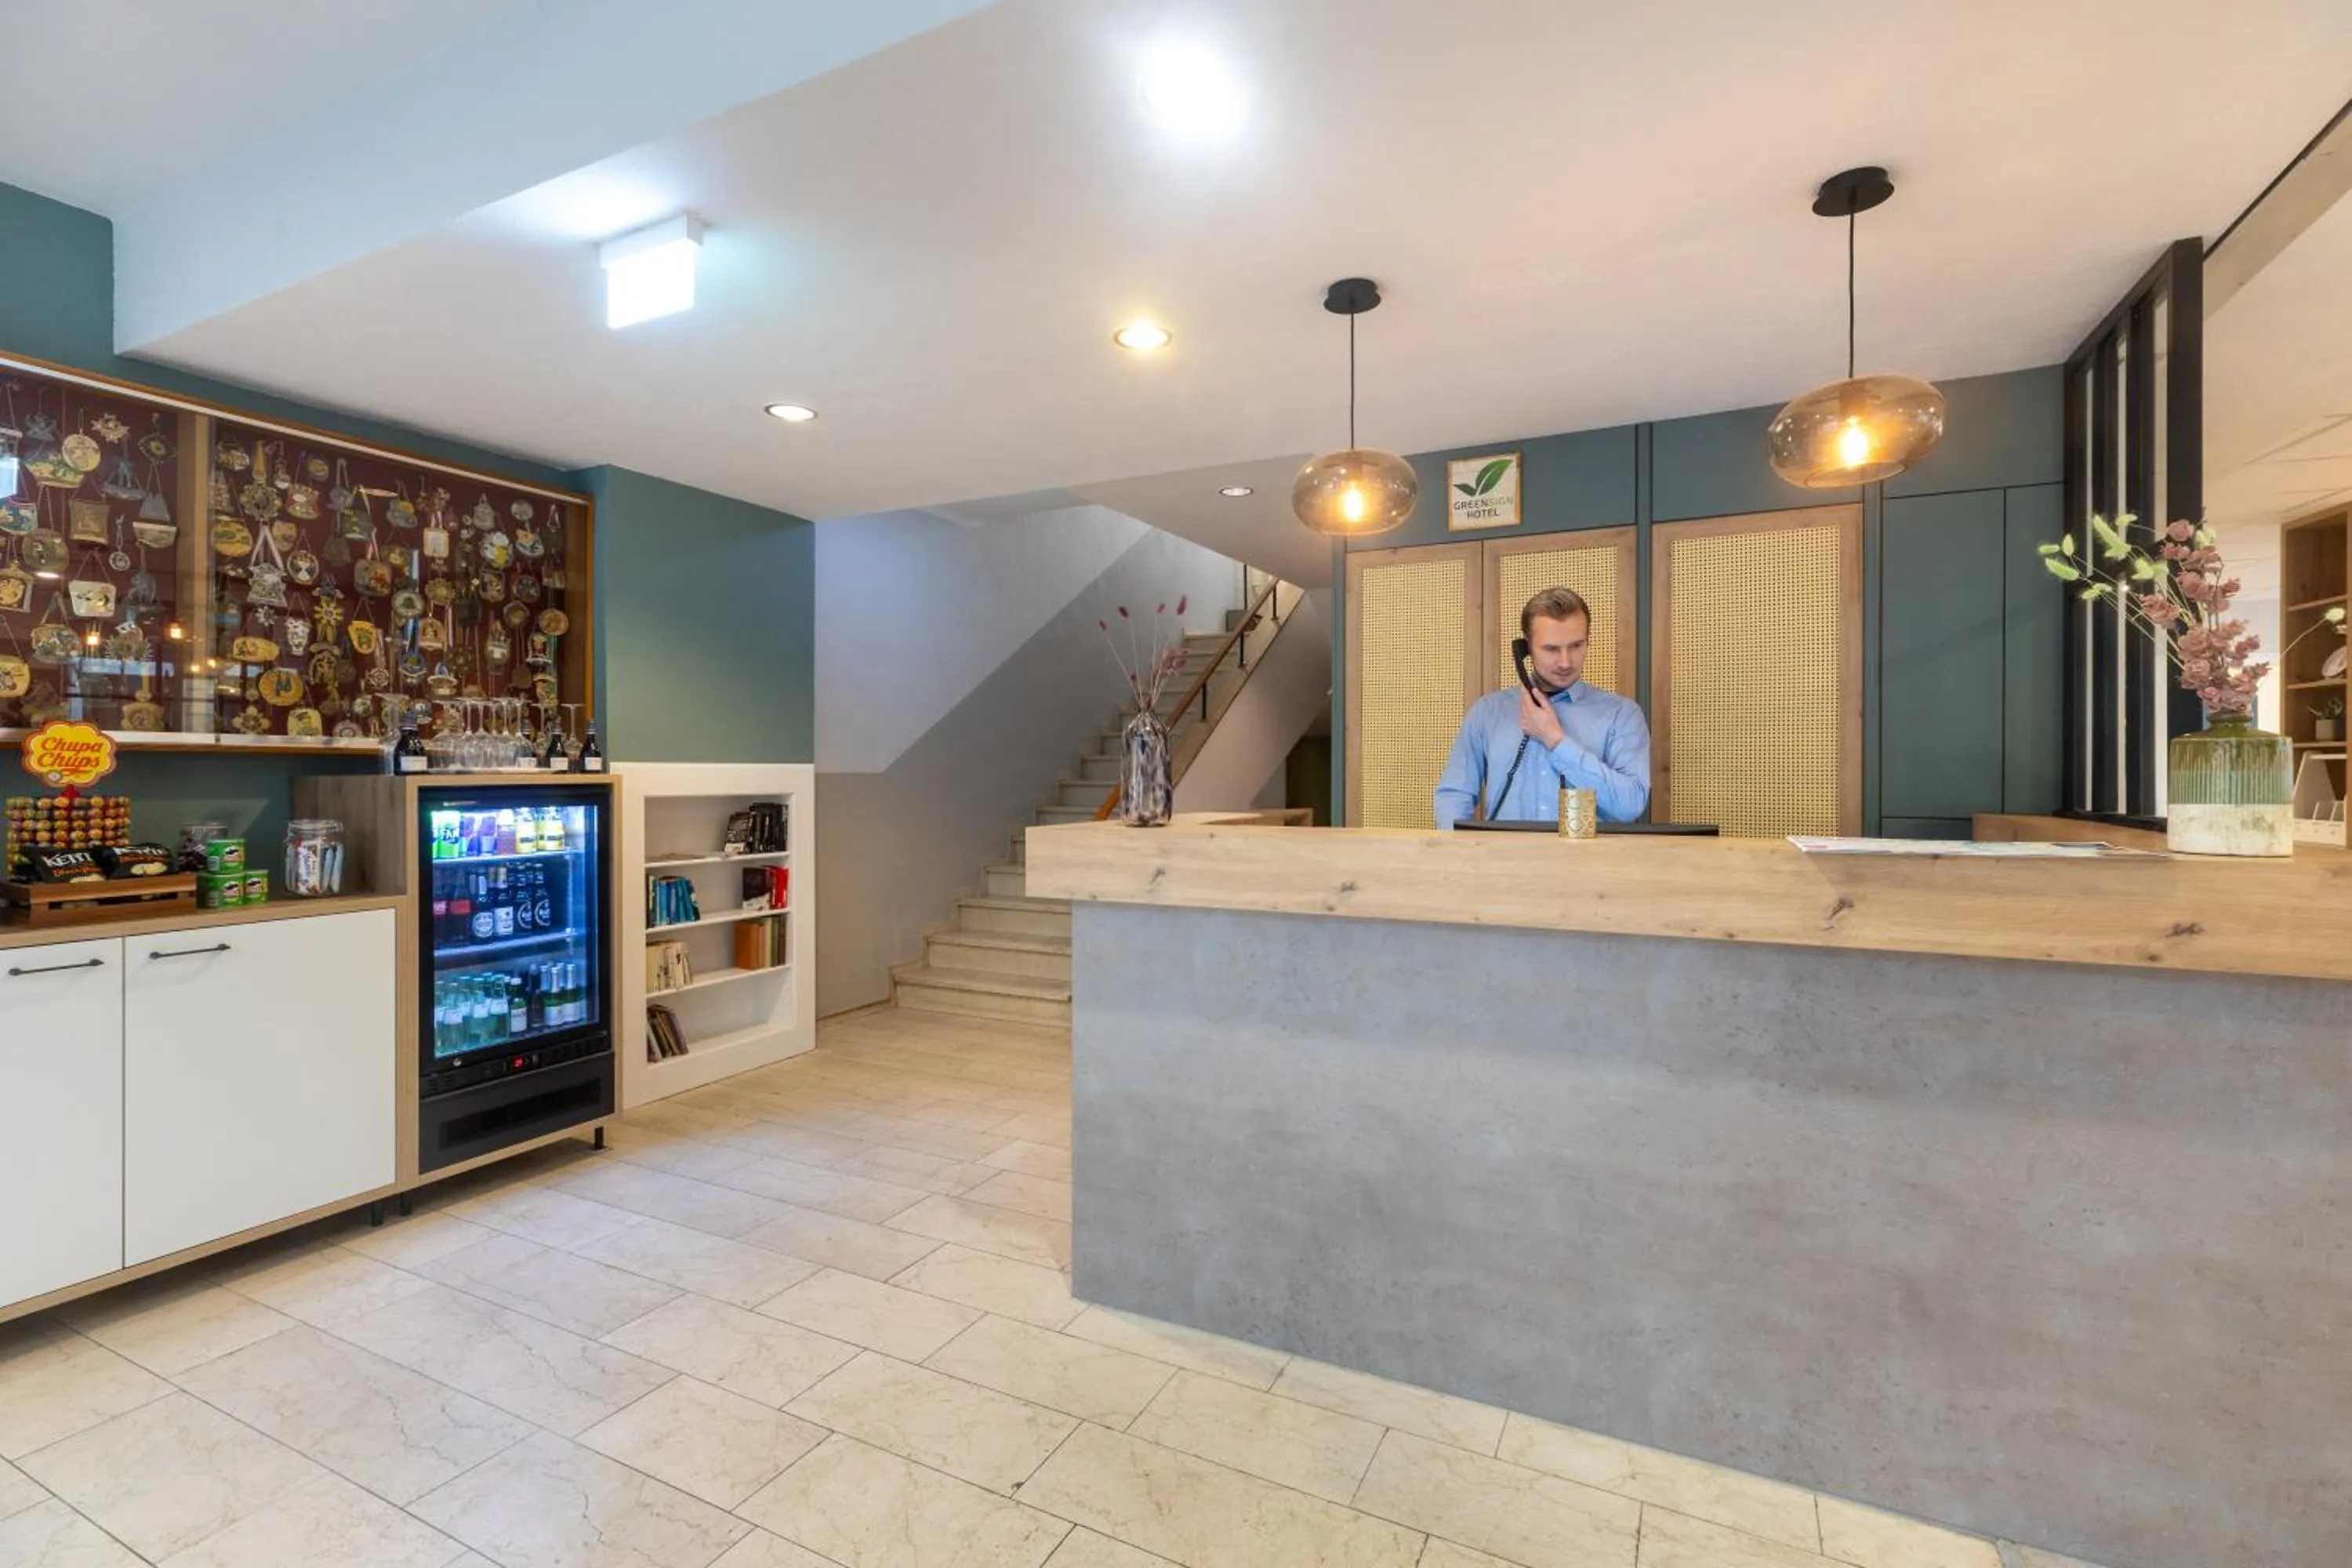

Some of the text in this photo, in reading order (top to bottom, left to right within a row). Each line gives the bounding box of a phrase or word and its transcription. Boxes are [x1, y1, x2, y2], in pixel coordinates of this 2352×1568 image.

[1454, 495, 1514, 510] GREENSIGN
[1467, 508, 1499, 519] HOTEL
[41, 737, 103, 757] Chupa
[38, 752, 100, 775] Chups
